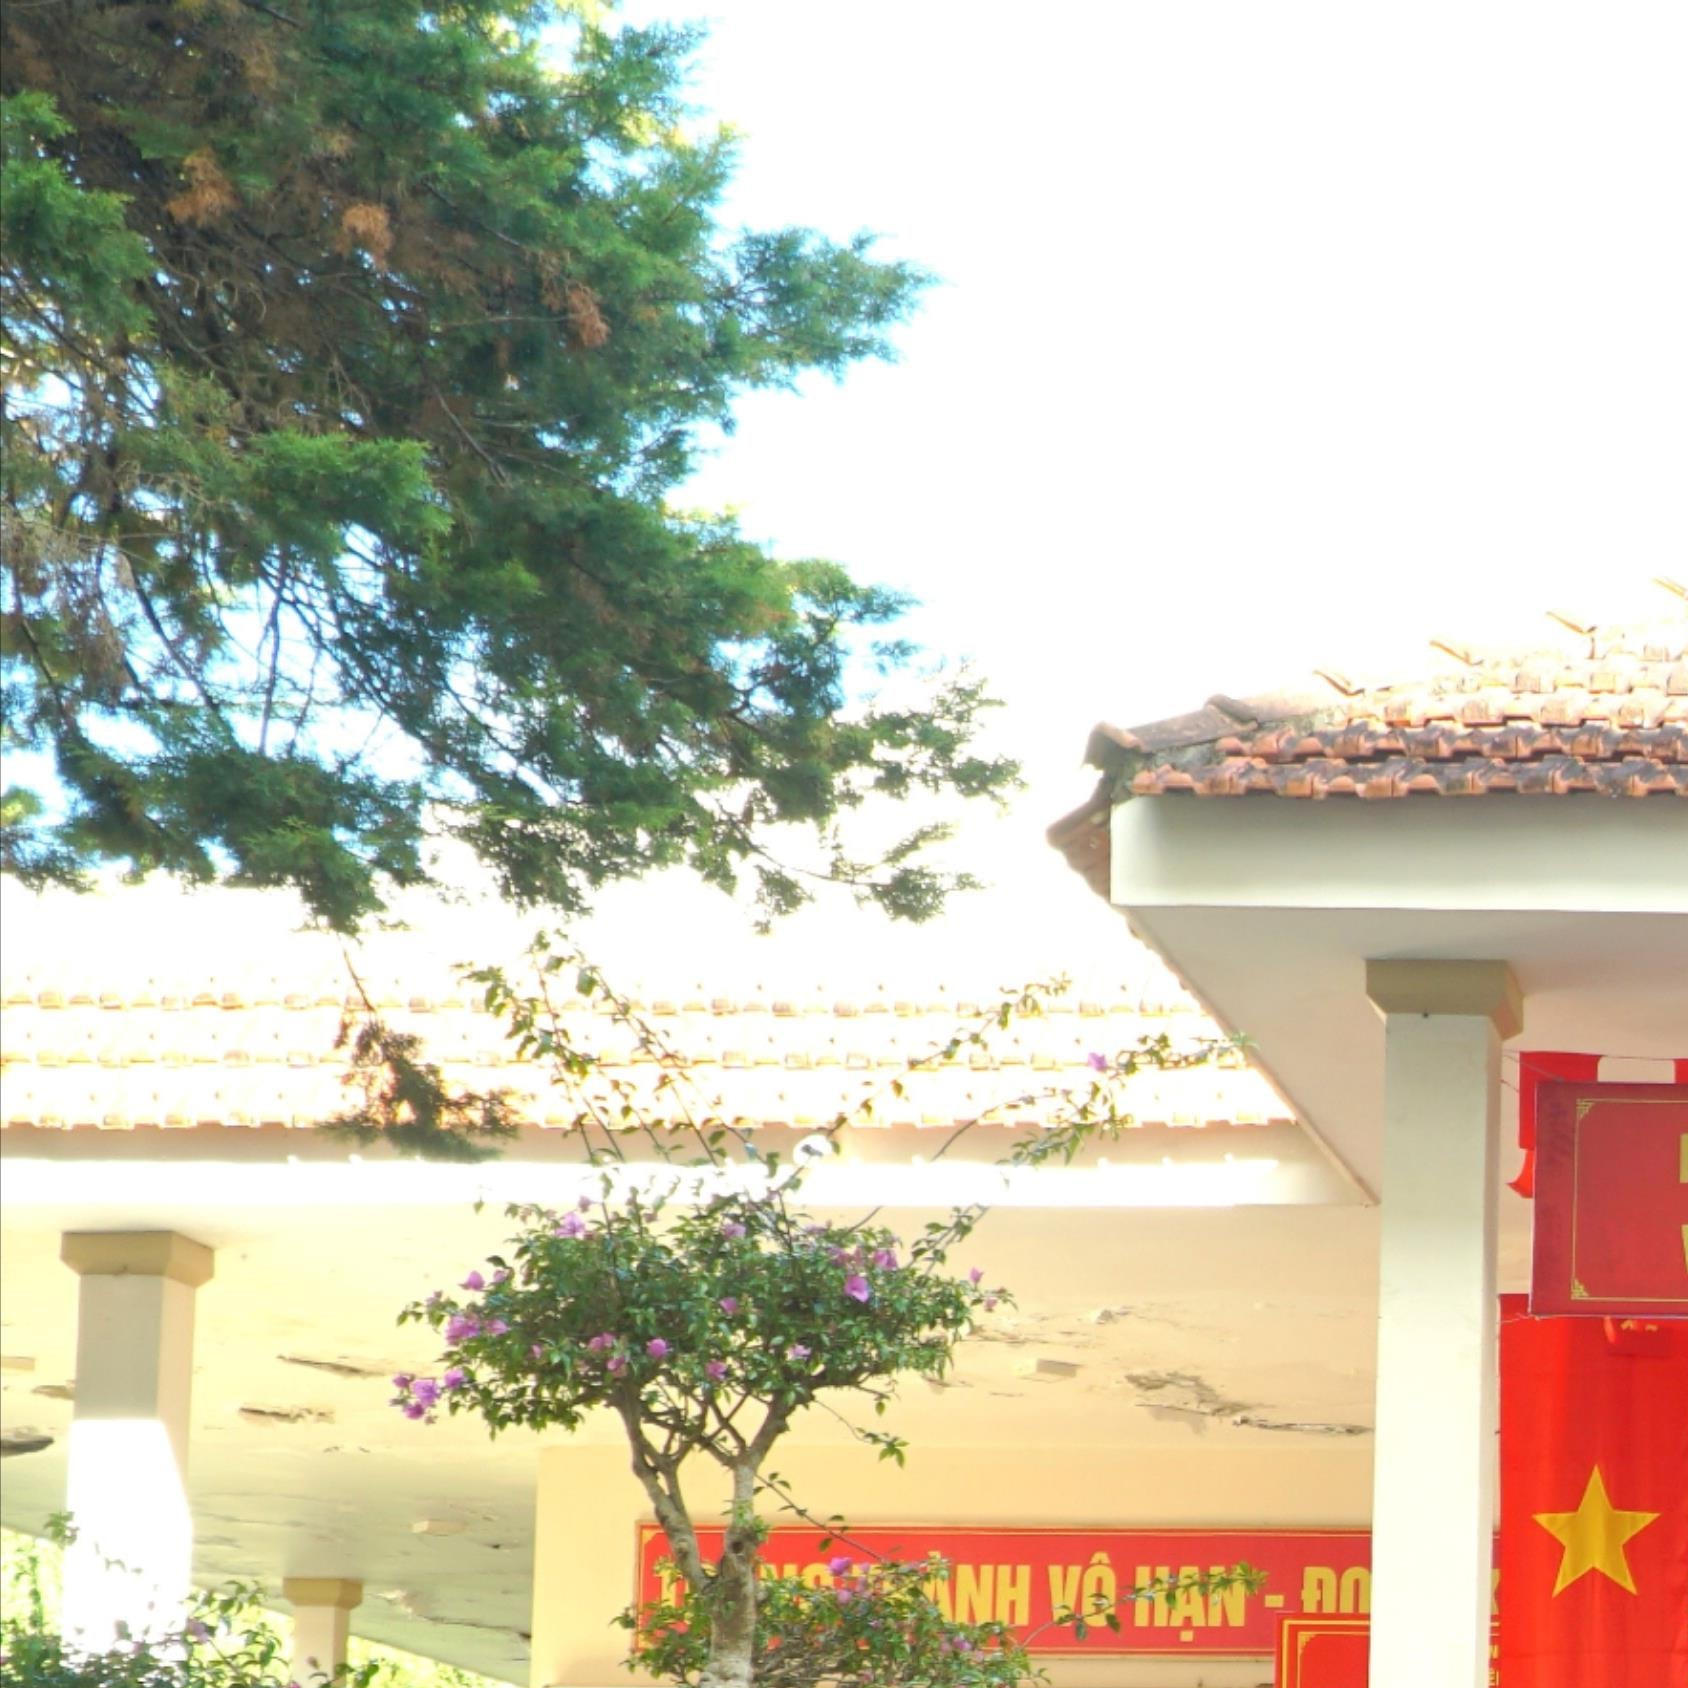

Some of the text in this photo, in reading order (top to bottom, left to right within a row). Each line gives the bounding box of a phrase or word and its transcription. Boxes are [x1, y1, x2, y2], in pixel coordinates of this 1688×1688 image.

[1047, 1551, 1117, 1628] VÔ
[1133, 1565, 1247, 1642] HẠN
[1265, 1594, 1285, 1608] -
